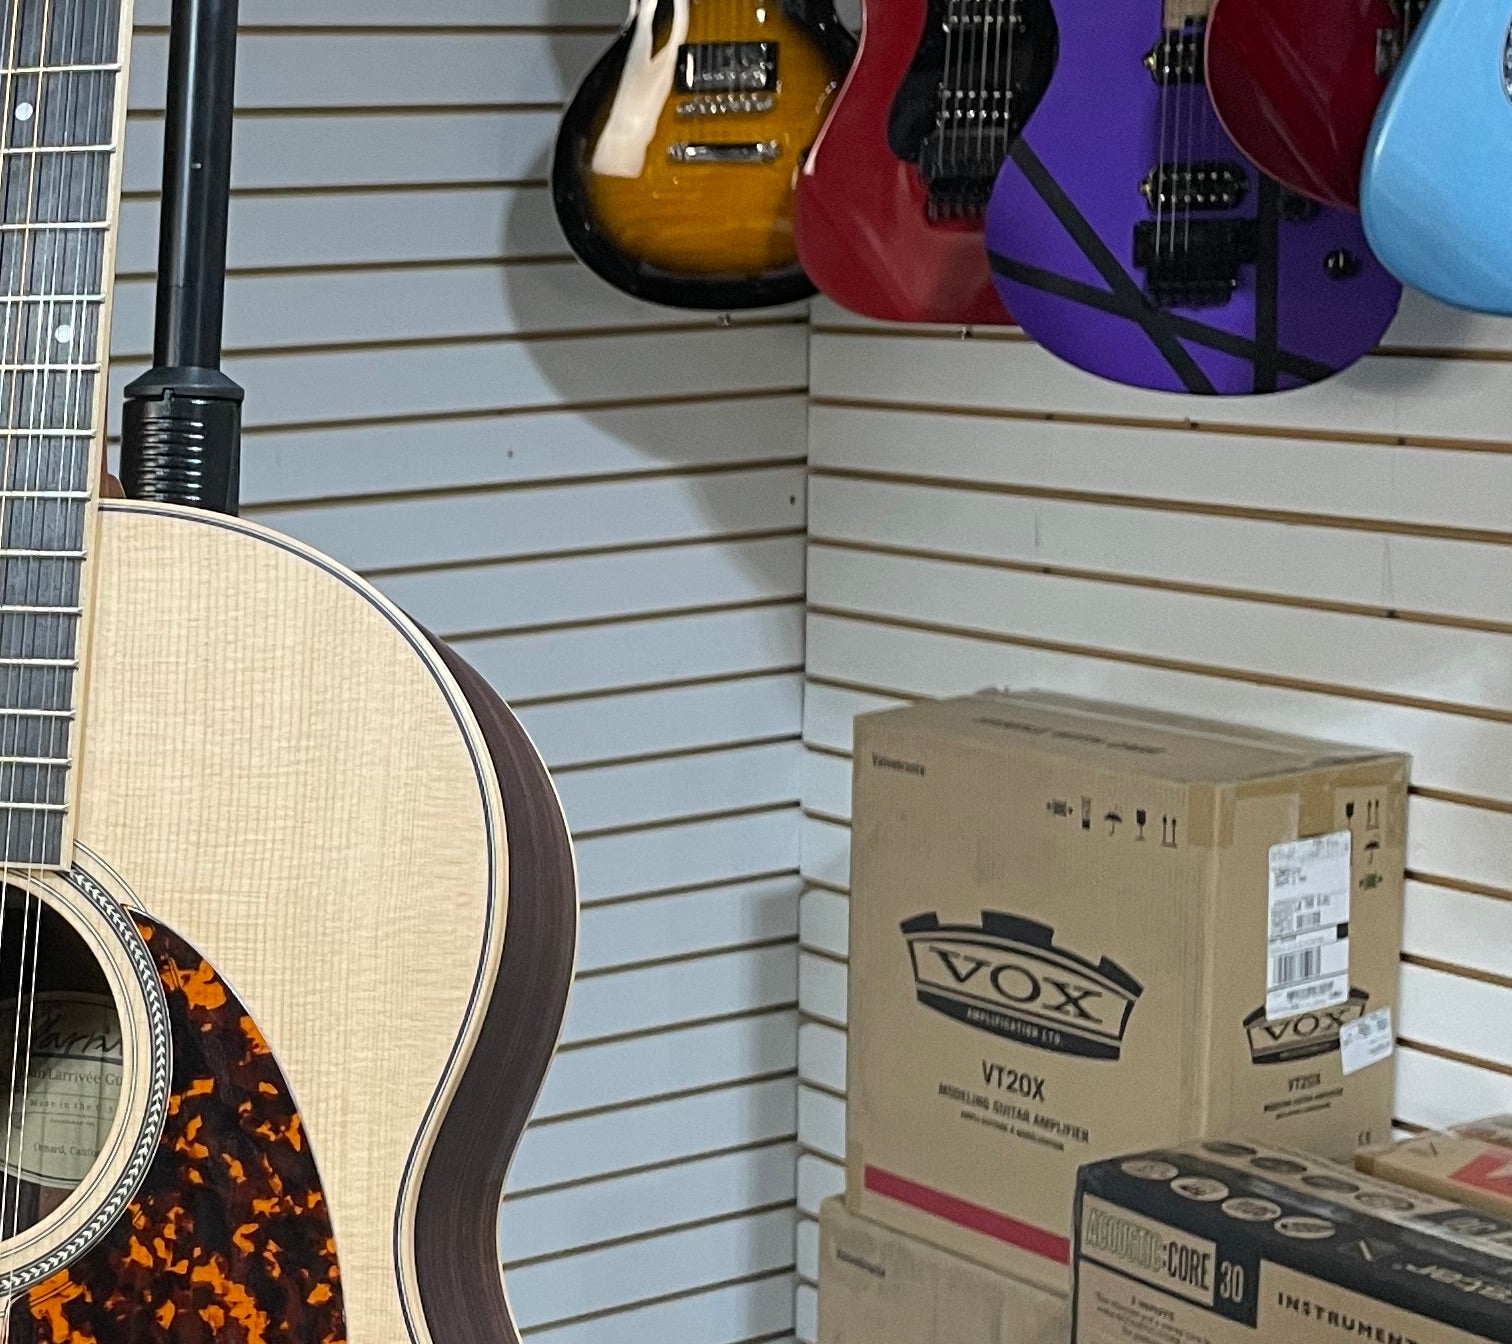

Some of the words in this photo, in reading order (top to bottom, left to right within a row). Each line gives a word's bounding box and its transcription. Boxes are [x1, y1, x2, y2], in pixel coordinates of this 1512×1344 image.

[929, 945, 1103, 1024] VOX
[1264, 1008, 1349, 1042] VOX
[982, 1060, 1046, 1102] VT20X
[992, 1099, 1030, 1124] GUITAR
[1219, 1260, 1245, 1304] 30
